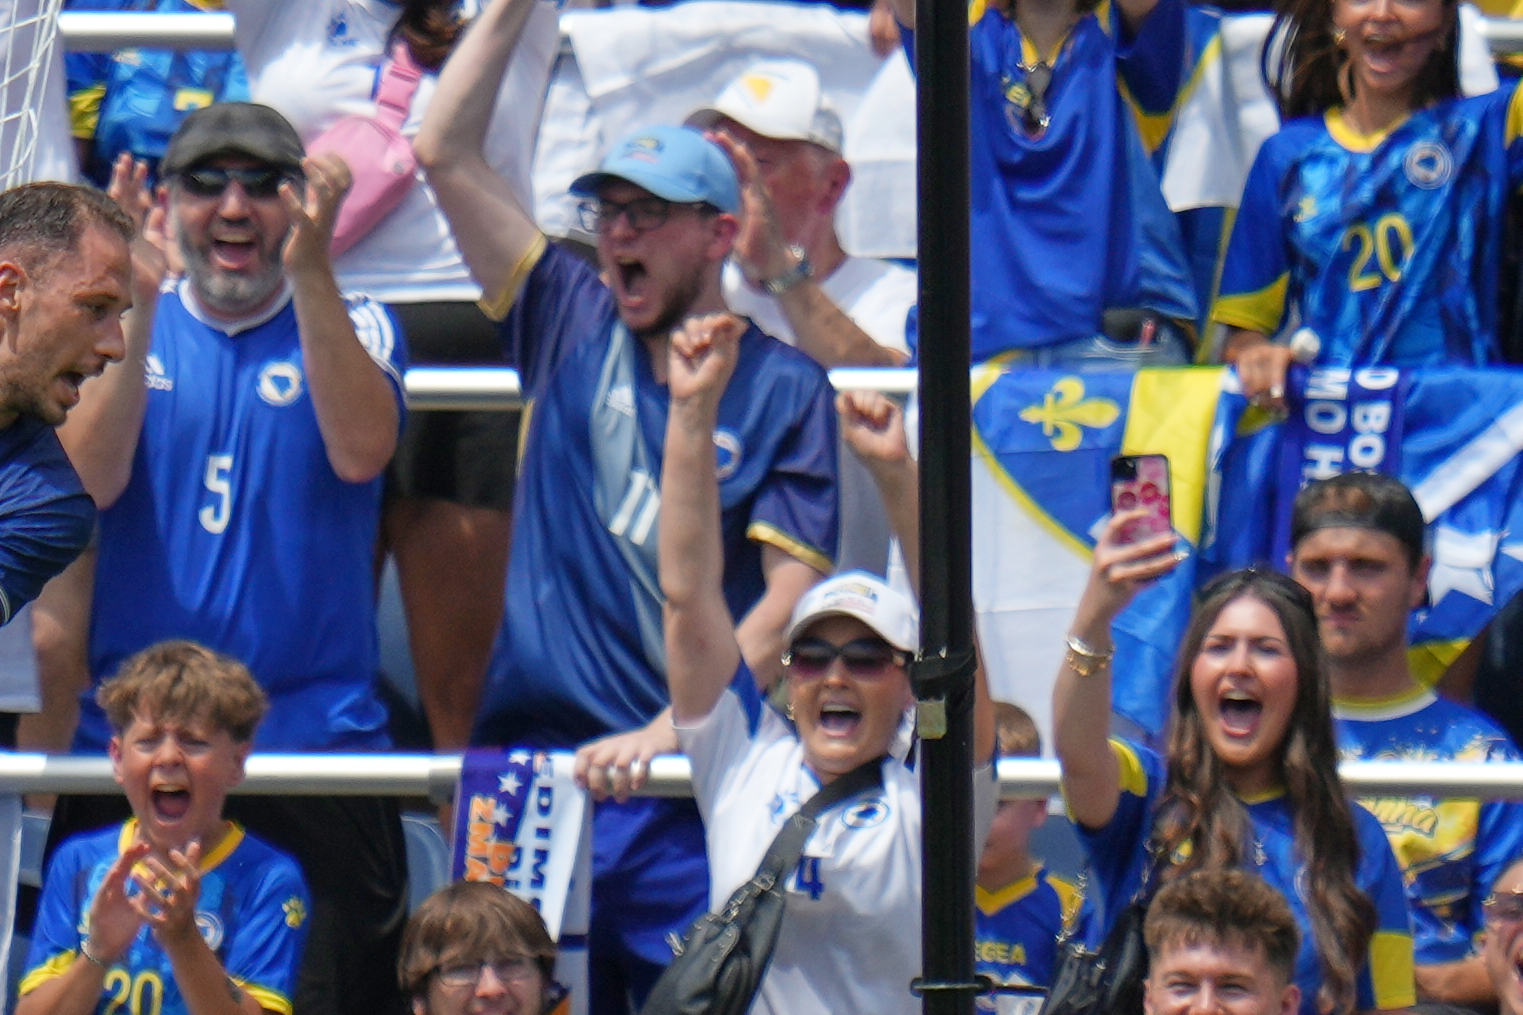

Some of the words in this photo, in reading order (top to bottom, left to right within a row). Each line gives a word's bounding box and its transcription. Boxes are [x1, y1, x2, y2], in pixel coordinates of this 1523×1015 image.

[1341, 211, 1415, 293] 20
[1347, 399, 1393, 475] BO
[198, 455, 234, 534] 5
